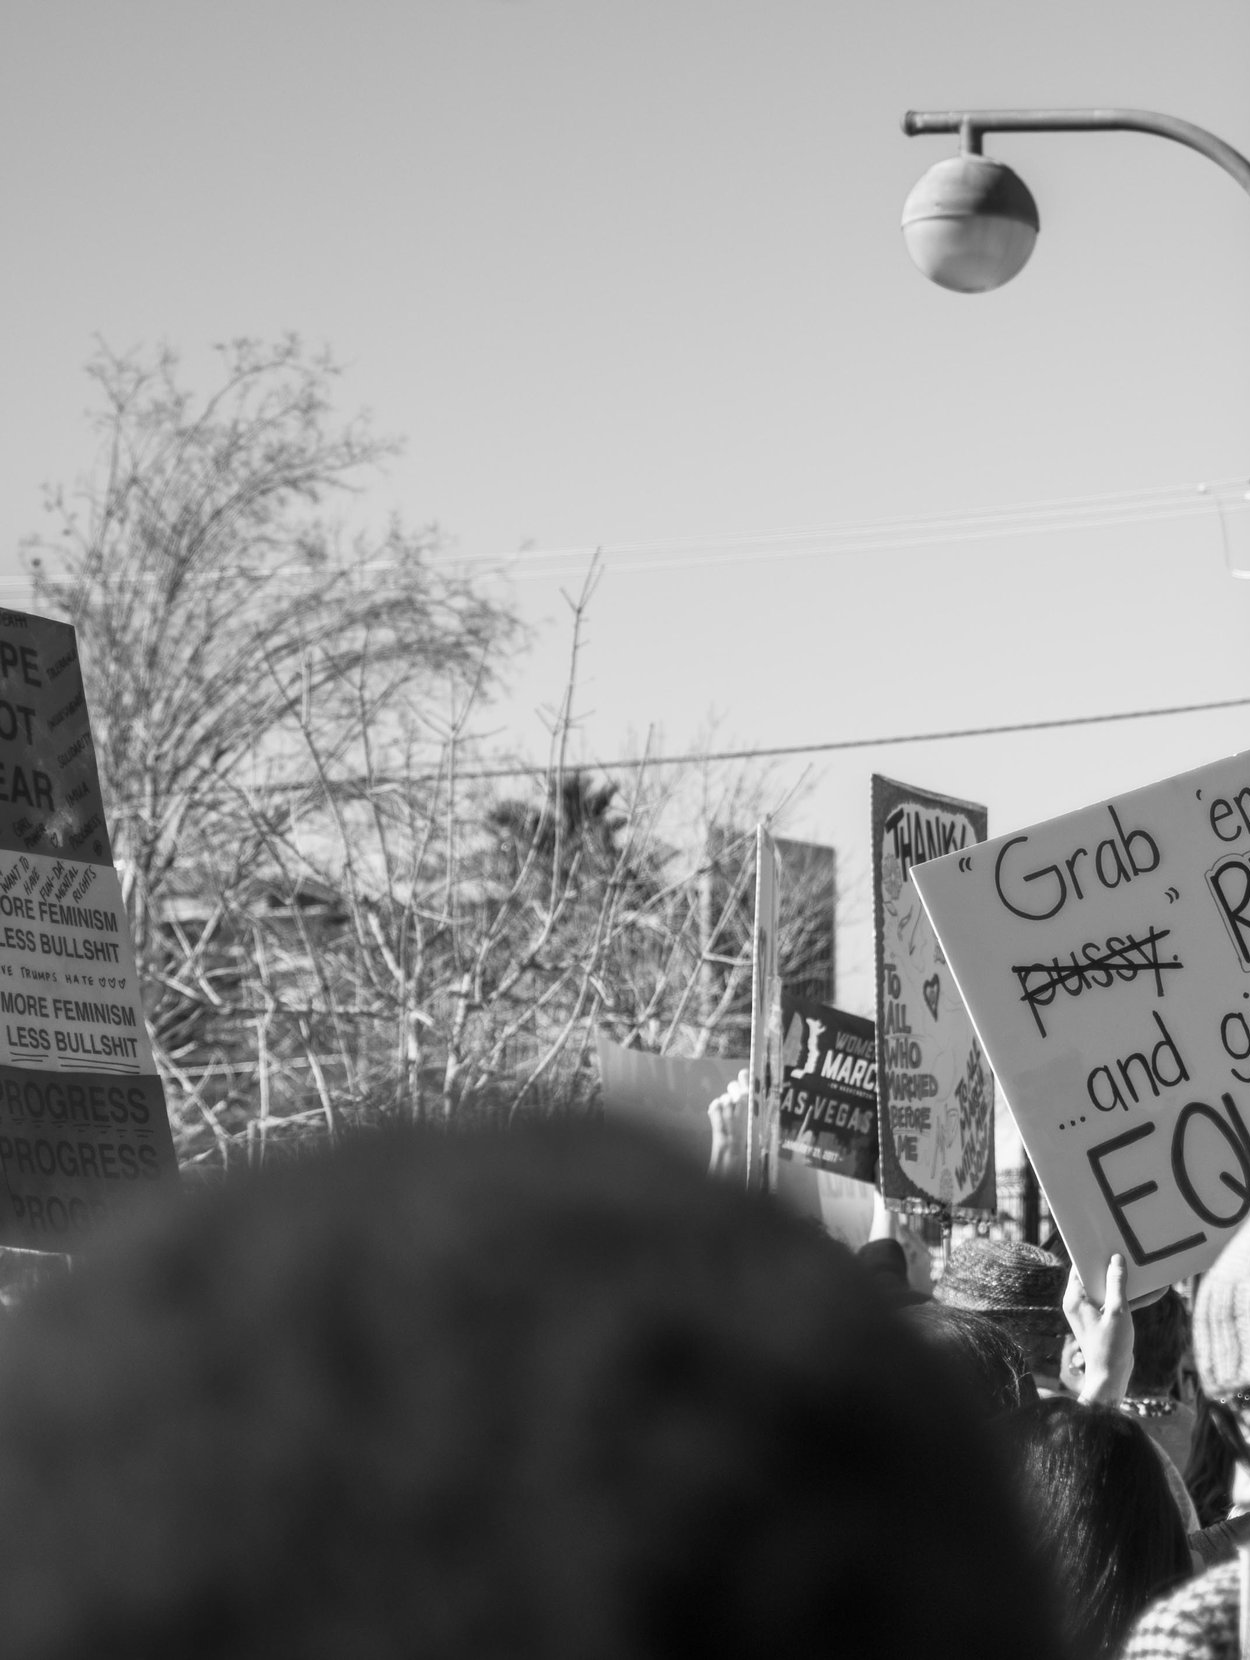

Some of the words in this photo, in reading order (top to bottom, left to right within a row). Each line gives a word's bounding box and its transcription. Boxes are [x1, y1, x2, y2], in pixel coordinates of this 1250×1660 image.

[23, 867, 40, 896] HAVE
[55, 866, 79, 903] MENTAL
[72, 865, 97, 904] RIGHTS
[39, 901, 118, 933] FEMINISM
[40, 933, 119, 964] BULLSHIT
[20, 966, 57, 982] TRUMPS
[65, 974, 94, 986] HATE
[883, 963, 901, 1000] TO
[1, 991, 50, 1018] MORE
[52, 998, 136, 1027] FEMINISM
[884, 1003, 911, 1035] ALL
[6, 1025, 51, 1050] LESS
[55, 1030, 138, 1059] BULLSHIT
[834, 1030, 876, 1059] WOME
[885, 1039, 922, 1070] WHO
[820, 1048, 878, 1094] MARC
[886, 1072, 938, 1101] MARCHED
[0, 1079, 149, 1124] ROGRESS
[781, 1087, 808, 1116] AS
[813, 1094, 874, 1135] VEGAS
[891, 1105, 932, 1131] BEFORE
